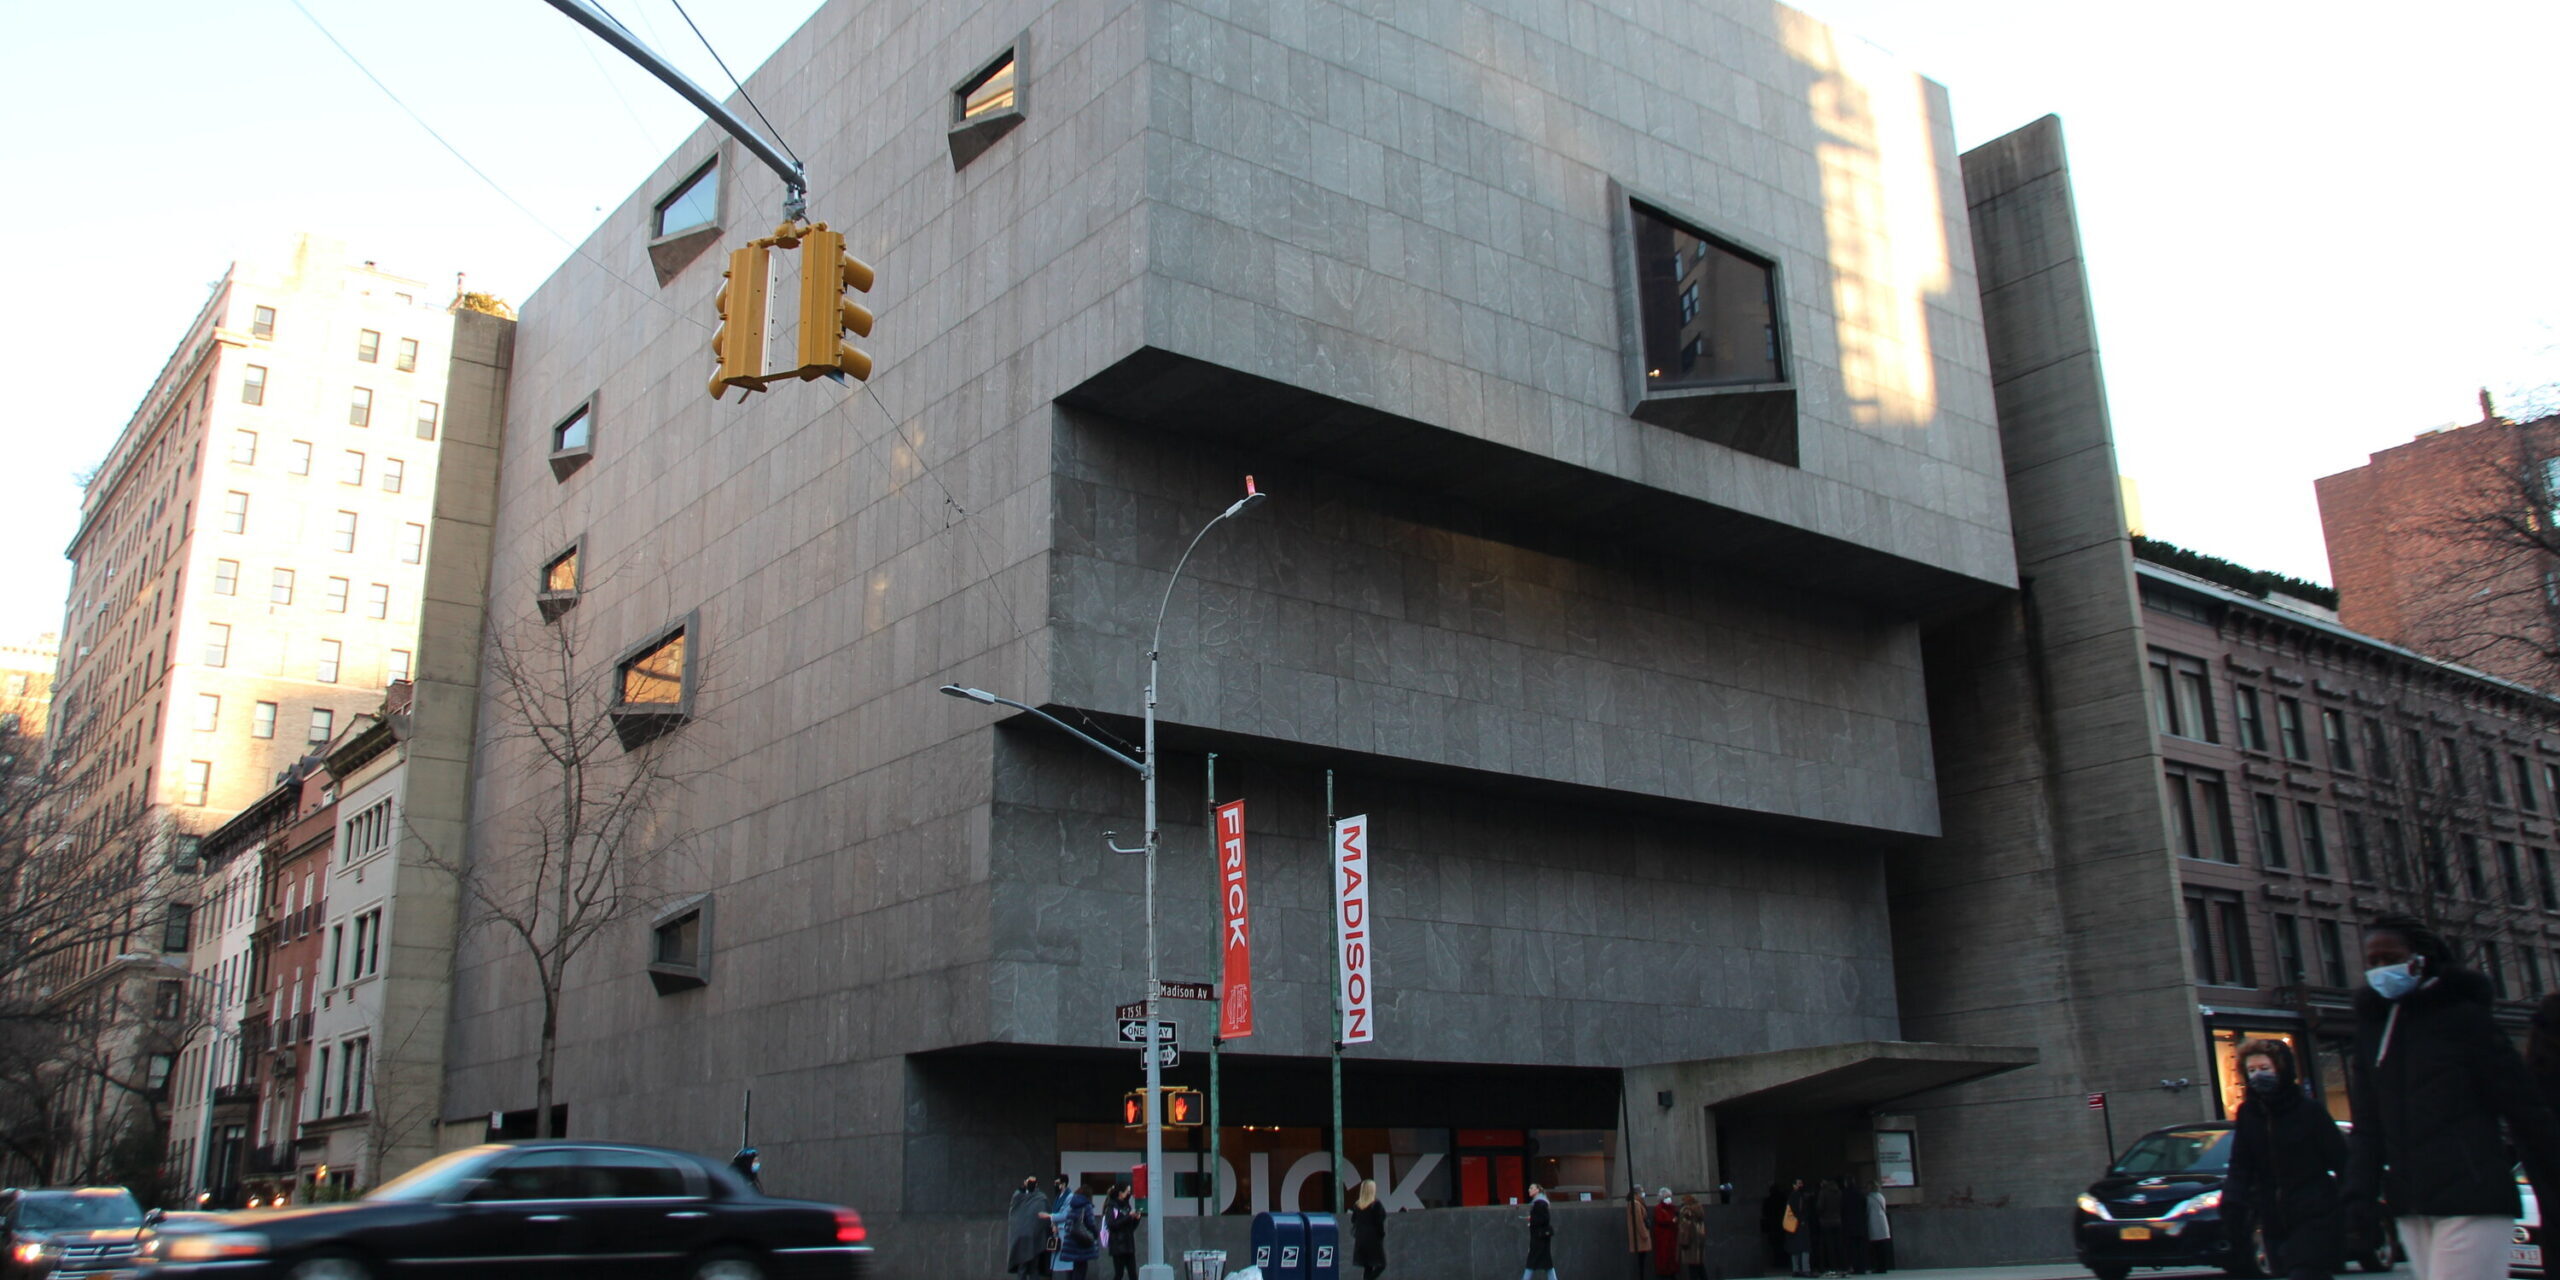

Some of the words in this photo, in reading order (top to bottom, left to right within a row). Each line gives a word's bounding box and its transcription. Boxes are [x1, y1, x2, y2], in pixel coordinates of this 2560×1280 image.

[1222, 807, 1246, 951] FRICK
[1342, 825, 1367, 1039] MADISON
[1160, 985, 1194, 998] Madison
[1197, 987, 1208, 999] Av
[1127, 1006, 1134, 1018] 75
[1135, 1004, 1142, 1017] St
[1128, 1027, 1144, 1036] ONE
[1162, 1051, 1173, 1060] WAY
